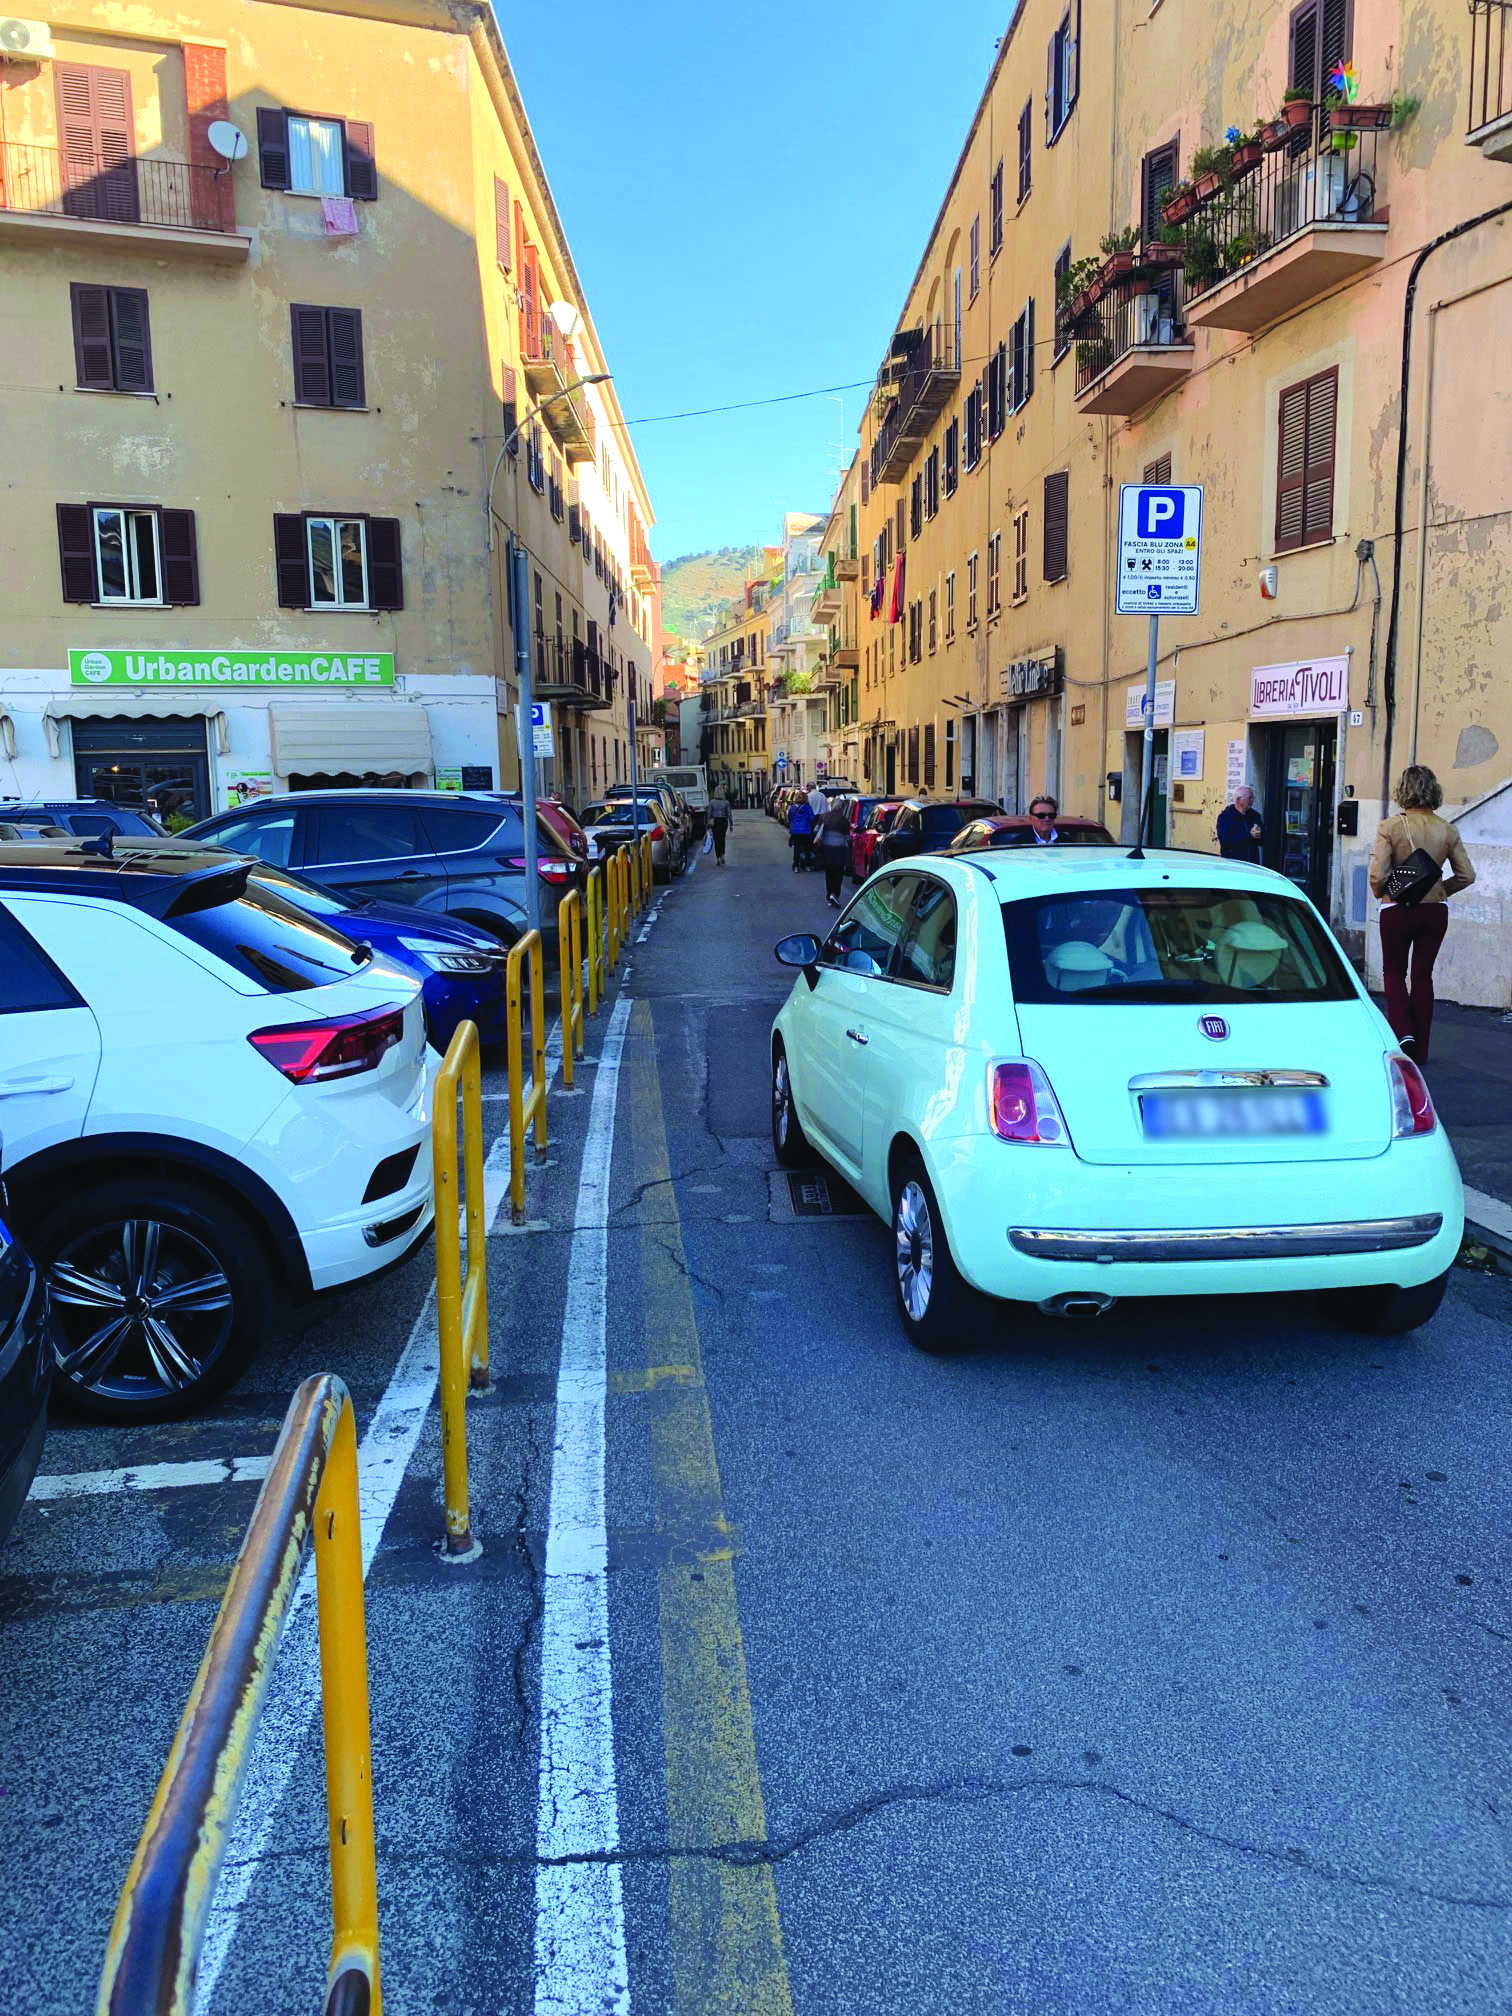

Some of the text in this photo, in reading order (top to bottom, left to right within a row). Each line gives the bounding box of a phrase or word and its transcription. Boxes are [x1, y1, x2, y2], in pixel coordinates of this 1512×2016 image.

[1148, 496, 1175, 532] P
[126, 655, 381, 681] UrbanGardenCAFE
[1352, 714, 1361, 724] 47
[1206, 1020, 1224, 1033] FIAT
